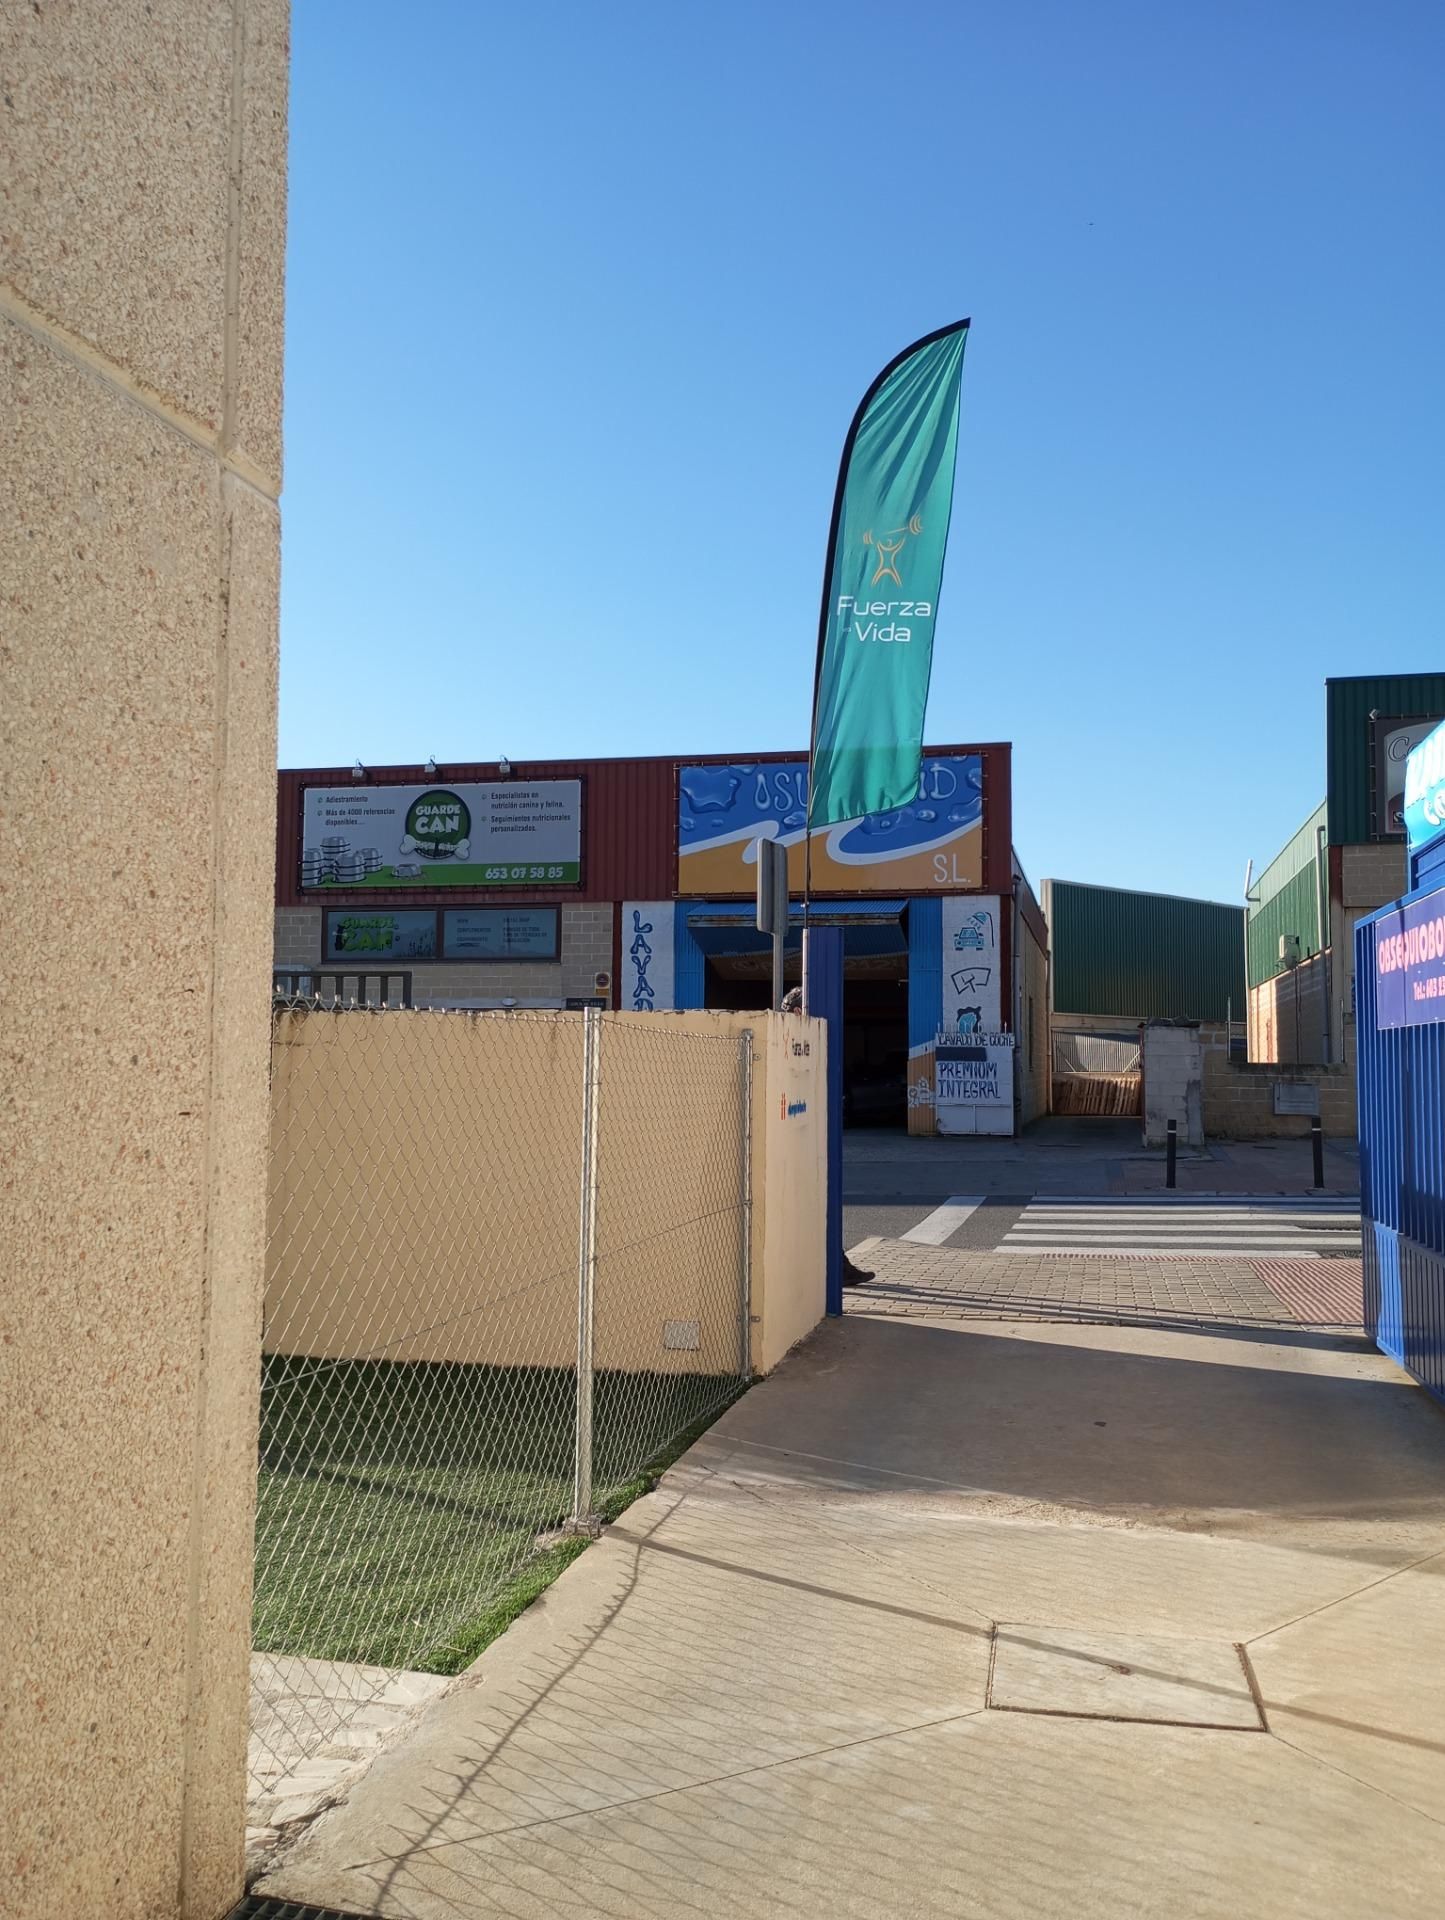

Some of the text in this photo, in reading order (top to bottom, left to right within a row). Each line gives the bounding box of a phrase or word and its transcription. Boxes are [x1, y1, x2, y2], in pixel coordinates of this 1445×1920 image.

[837, 595, 932, 617] Fuerza
[854, 621, 912, 642] Vida
[491, 792, 530, 801] Especialistas
[325, 808, 338, 816] Más
[339, 808, 346, 816] de
[415, 804, 461, 816] GUARDE
[519, 801, 539, 809] canina
[415, 815, 460, 834] CAN
[490, 814, 571, 825] Seguimientos nutricionales
[484, 866, 564, 880] 653 07 58 85
[932, 853, 972, 884] S.L.
[1379, 916, 1445, 974] OBSEQUIOBO
[937, 1032, 972, 1046] LAVADO
[974, 1032, 988, 1047] DE
[938, 1062, 998, 1079] PREMIUM
[937, 1080, 1001, 1099] INTEGRAL
